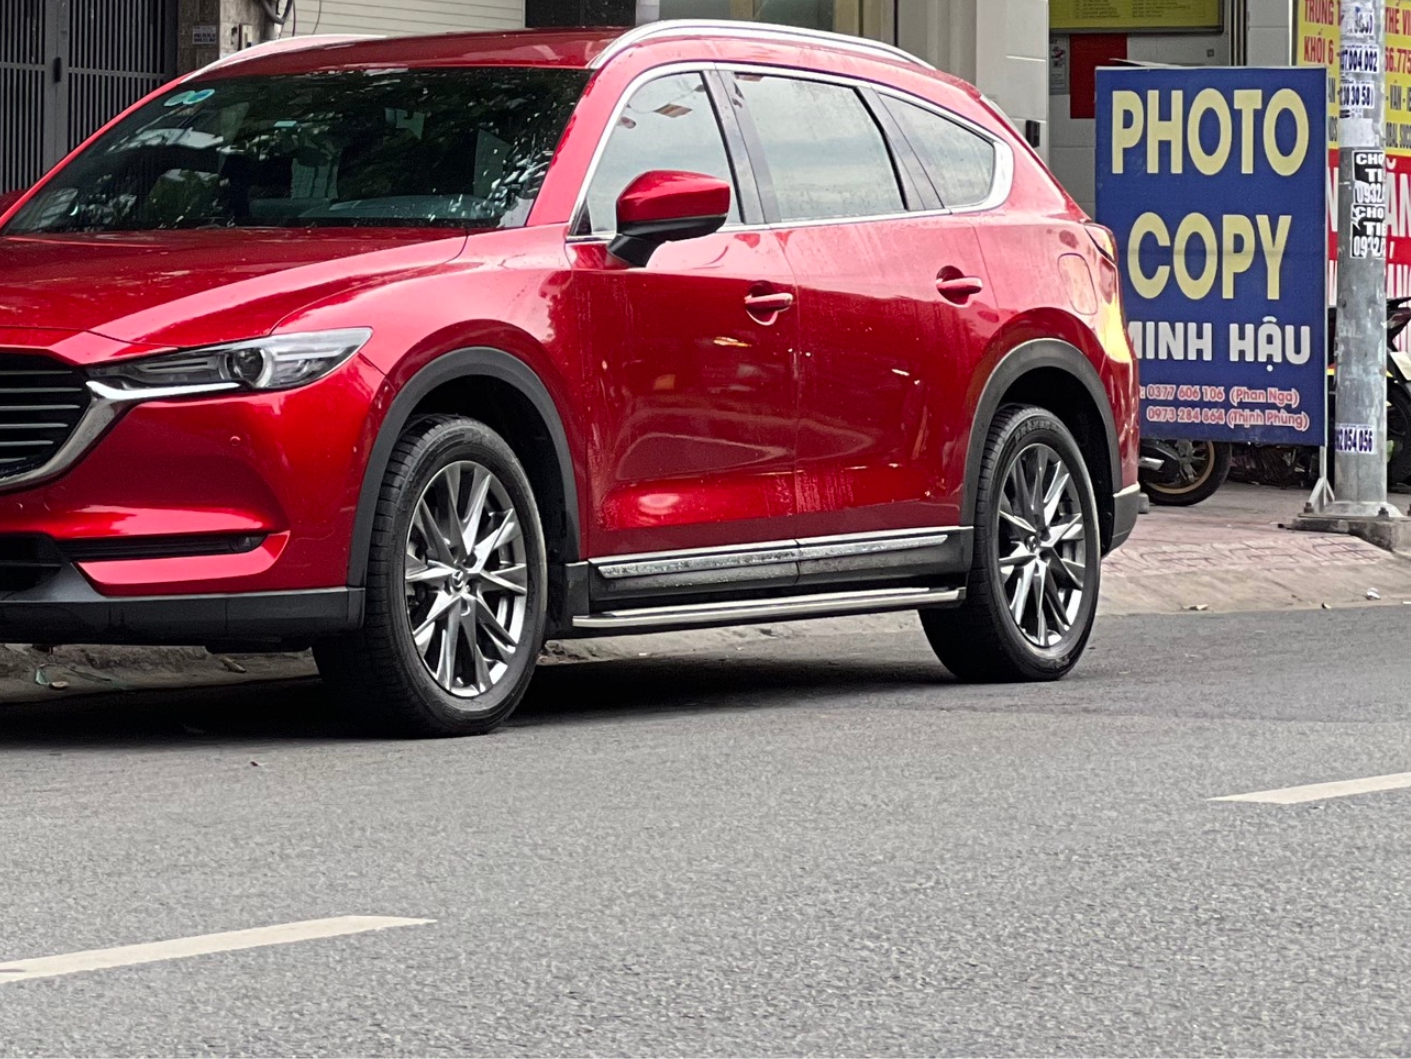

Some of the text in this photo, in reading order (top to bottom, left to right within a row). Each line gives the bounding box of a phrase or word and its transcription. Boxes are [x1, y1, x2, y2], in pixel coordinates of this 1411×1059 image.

[1303, 28, 1325, 62] KHỐI
[1328, 39, 1334, 65] 6
[1112, 88, 1309, 177] PHOTO
[1128, 213, 1292, 301] COPY
[1229, 316, 1310, 372] HẬU
[1146, 384, 1176, 401] 0377
[1177, 385, 1200, 401] 606
[1202, 386, 1225, 402] 106
[1229, 386, 1266, 407] (Phan
[1267, 388, 1300, 408] Nga)
[1146, 406, 1176, 422] 0973
[1177, 407, 1200, 423] 284
[1202, 409, 1225, 424] 864
